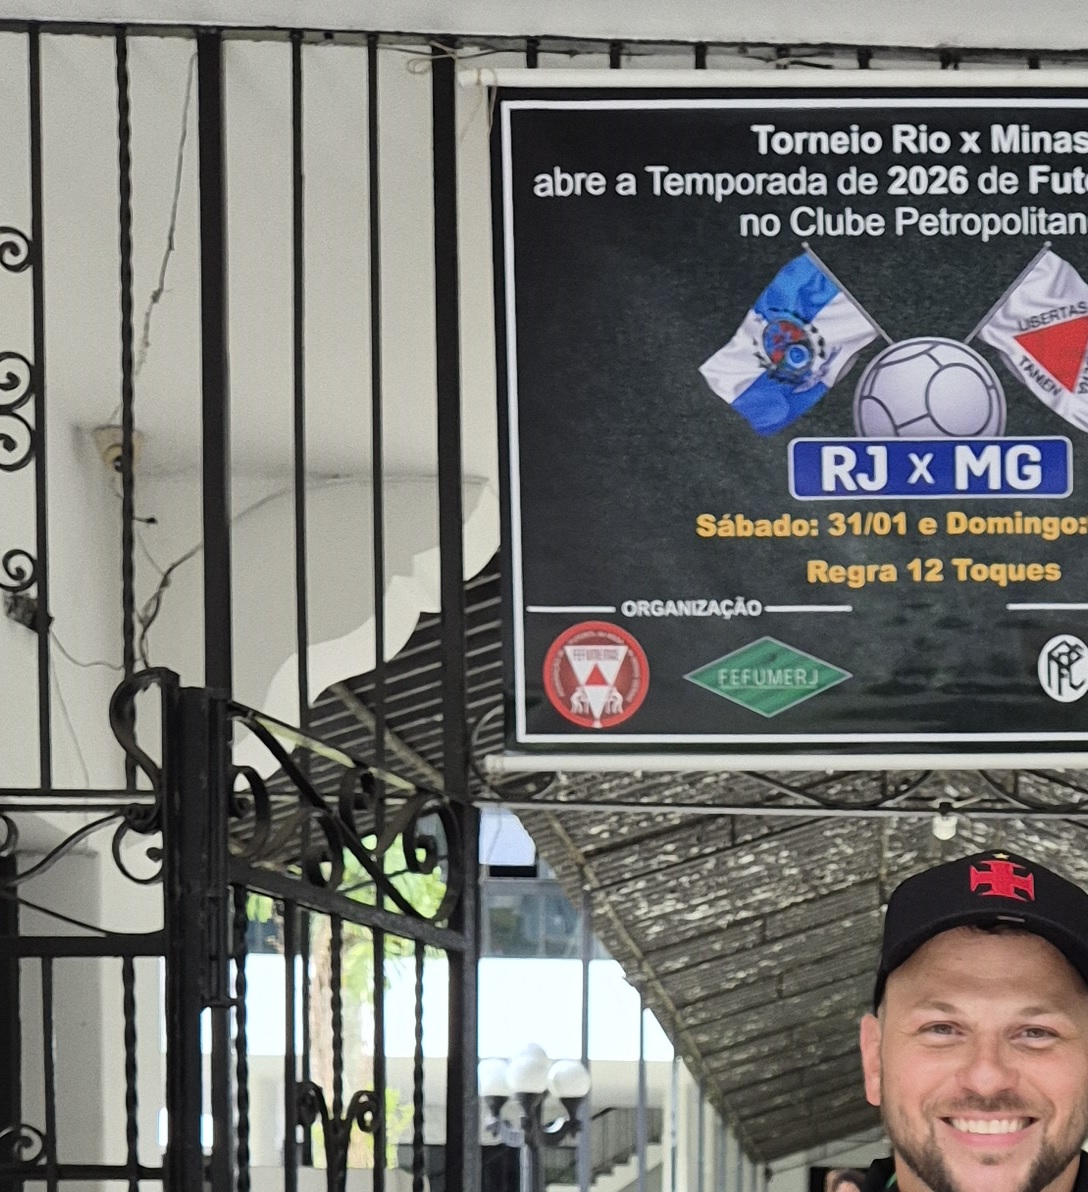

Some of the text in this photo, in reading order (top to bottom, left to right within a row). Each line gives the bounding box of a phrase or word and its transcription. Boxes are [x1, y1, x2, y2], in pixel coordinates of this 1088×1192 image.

[750, 124, 882, 156] Torneio
[892, 124, 950, 154] Rio
[960, 131, 981, 153] x
[533, 166, 606, 197] abre
[615, 173, 637, 196] a
[644, 165, 828, 203] Temporada
[838, 166, 878, 196] de
[887, 165, 969, 196] 2026
[978, 165, 1019, 195] de
[739, 212, 781, 237] no
[790, 206, 885, 237] Clube
[821, 444, 1042, 492] RJ x MG
[696, 513, 819, 538] Sábado:
[827, 511, 907, 536] 31/01
[918, 518, 938, 535] e
[807, 558, 1061, 588] Regra 12 Toques
[621, 596, 762, 620] ORGANIZAÇÃO
[718, 668, 819, 687] FEFUMERJ
